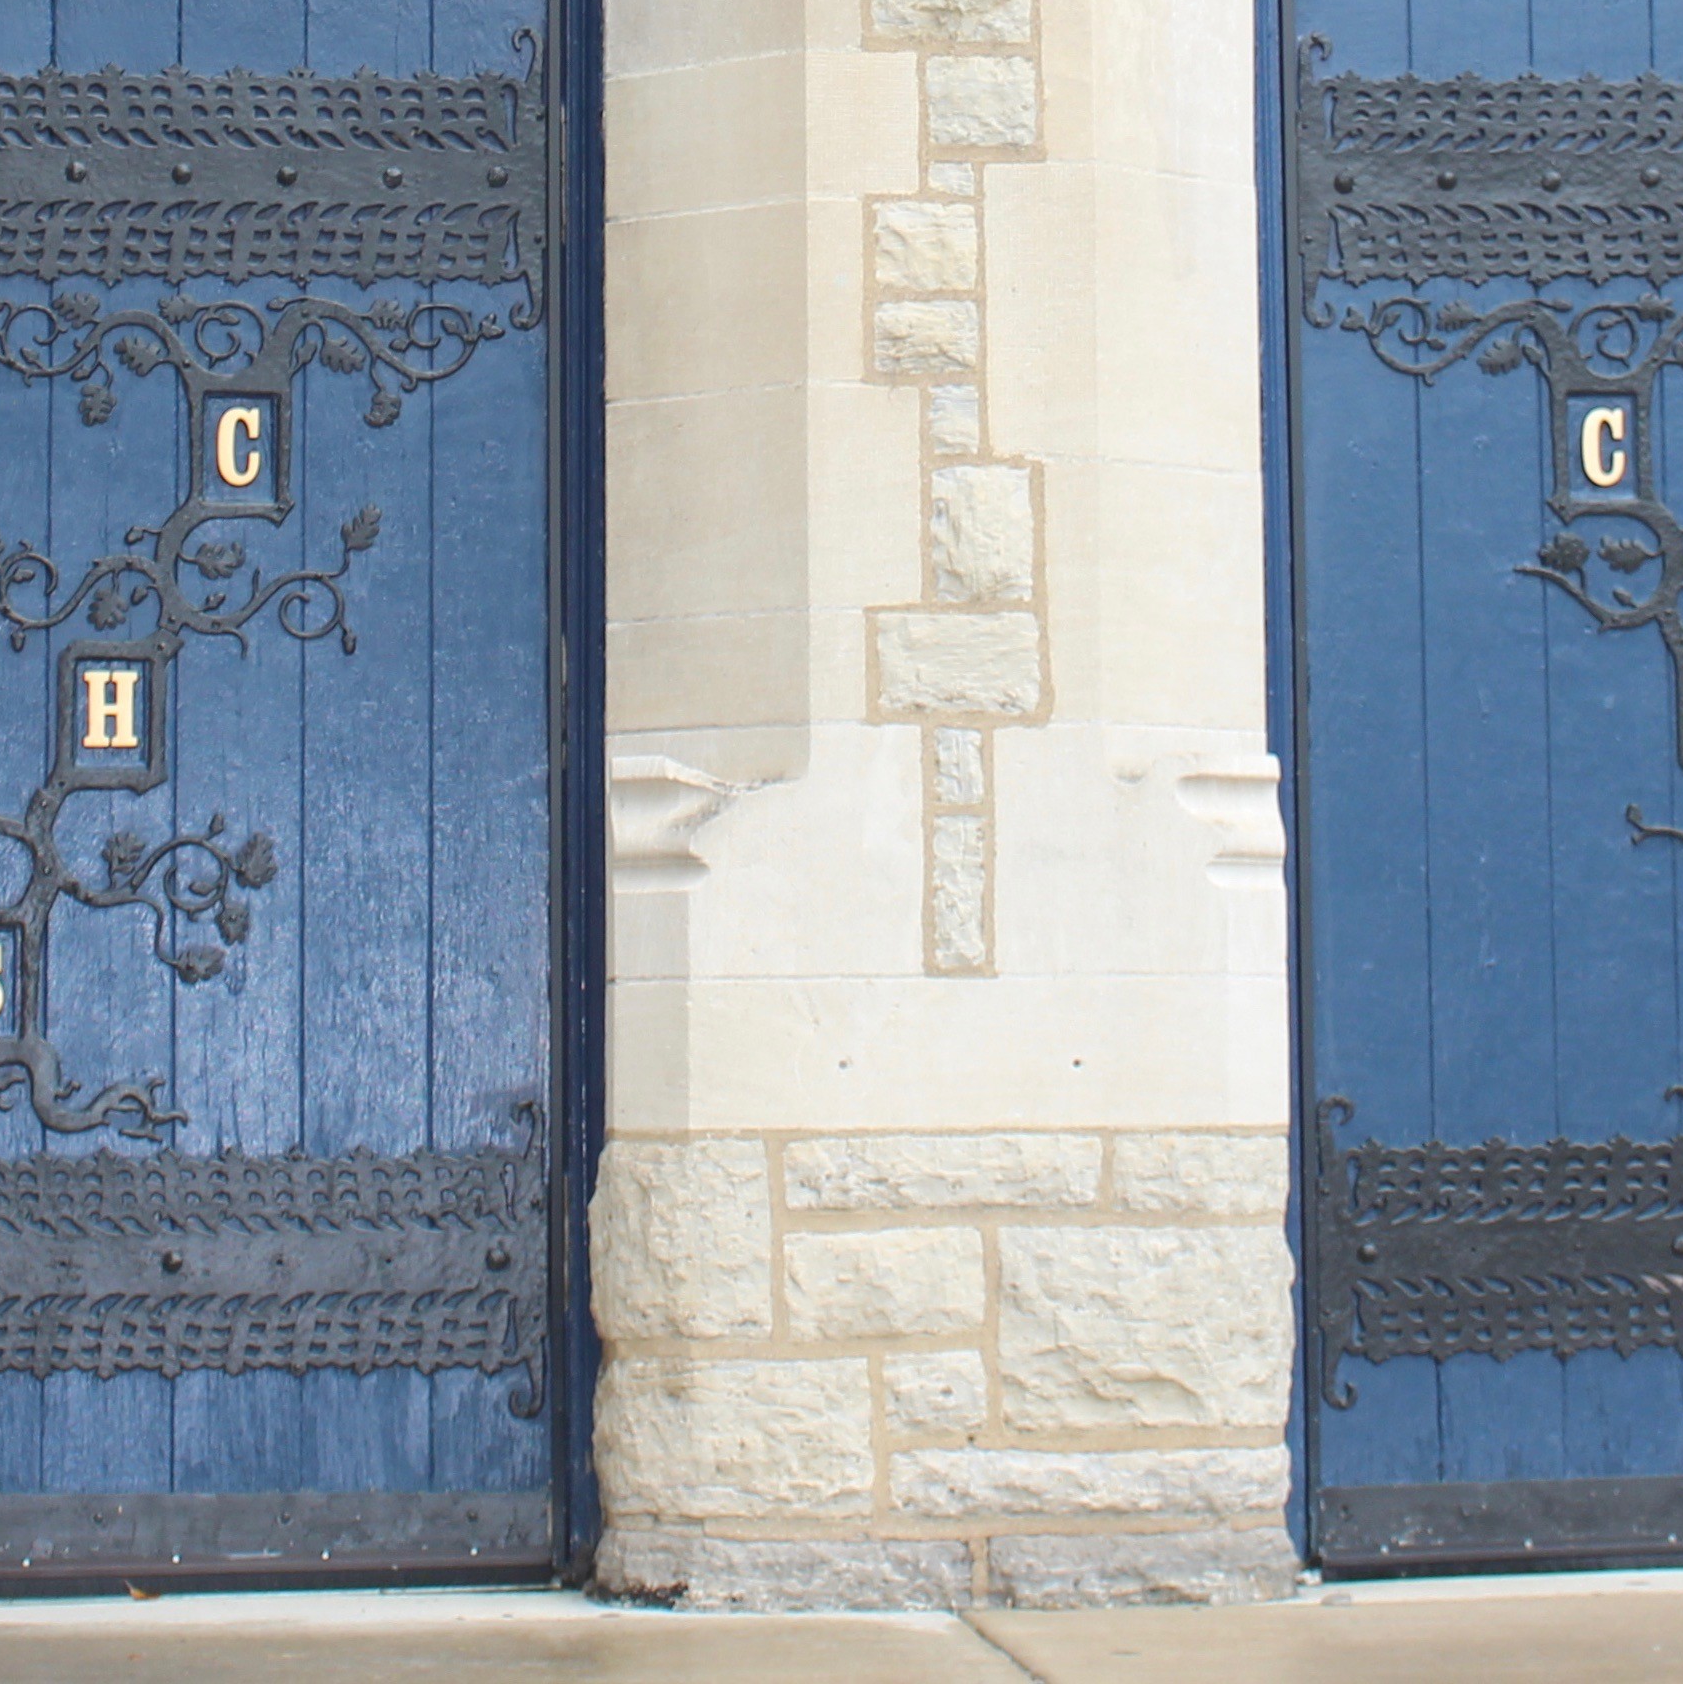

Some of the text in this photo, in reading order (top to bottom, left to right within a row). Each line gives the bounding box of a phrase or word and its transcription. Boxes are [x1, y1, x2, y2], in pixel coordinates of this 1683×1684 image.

[217, 408, 260, 486] C
[1582, 409, 1626, 486] C
[83, 670, 138, 748] H
